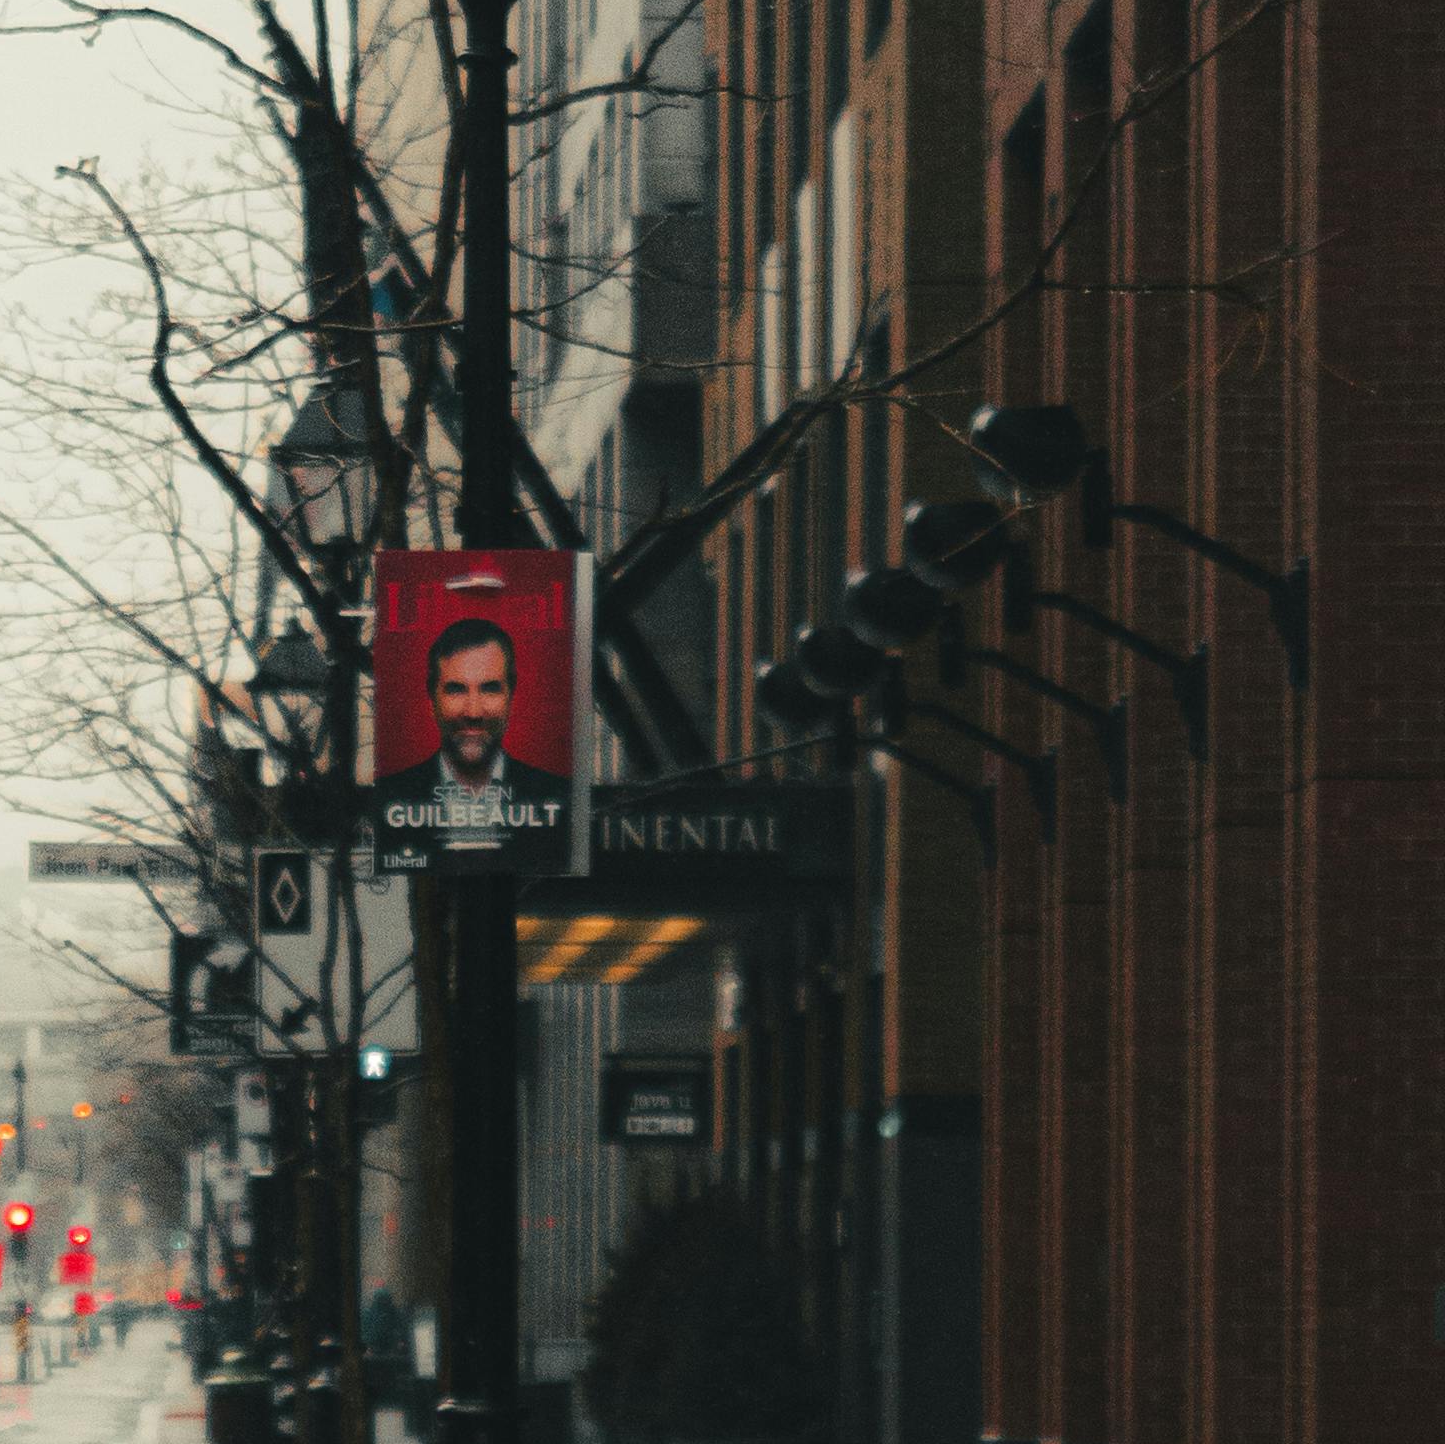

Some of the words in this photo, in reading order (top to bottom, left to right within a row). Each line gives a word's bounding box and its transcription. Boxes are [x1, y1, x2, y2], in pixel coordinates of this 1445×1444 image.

[387, 580, 565, 631] Libal
[433, 785, 513, 802] STEVEN
[386, 803, 561, 828] GUILBEAULT
[602, 814, 779, 851] INENTAL
